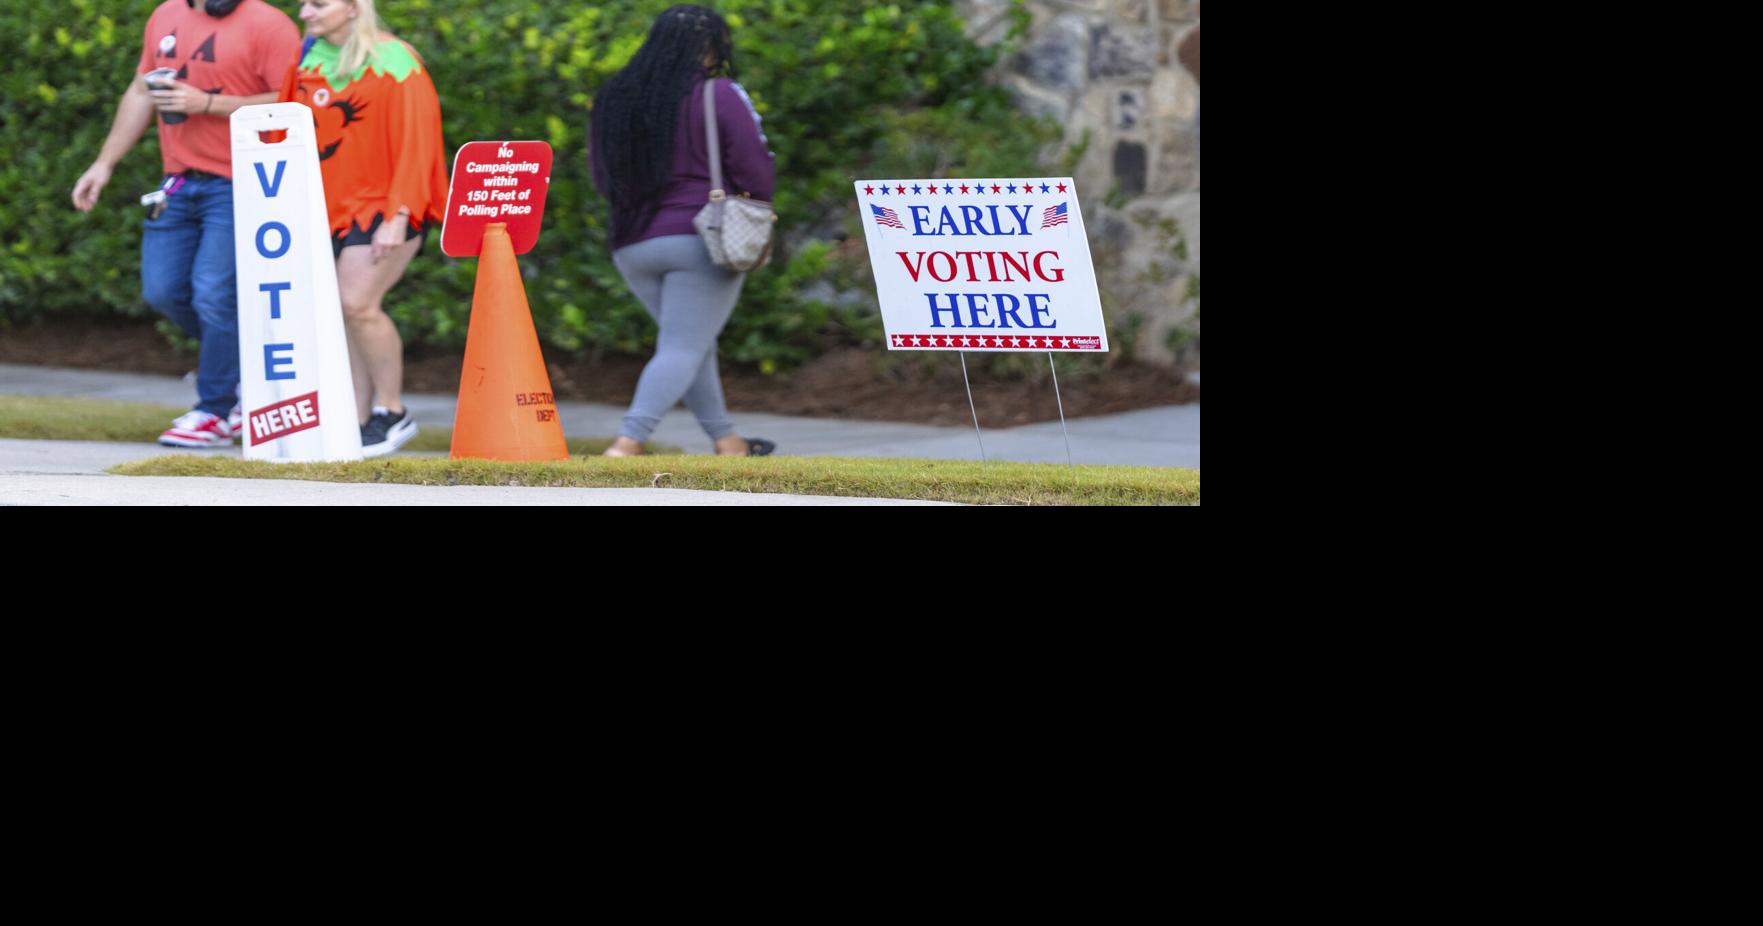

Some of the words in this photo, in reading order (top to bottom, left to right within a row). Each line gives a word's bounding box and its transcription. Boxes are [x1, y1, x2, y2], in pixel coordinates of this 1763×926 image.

[497, 147, 513, 158] No
[466, 161, 540, 175] Campaigning
[483, 176, 518, 187] within
[467, 191, 489, 202] 150
[490, 190, 516, 201] Feet
[518, 189, 531, 200] of
[458, 204, 498, 217] Polling
[500, 203, 532, 215] Place
[908, 204, 1034, 236] EARLY
[253, 160, 297, 381] VOTE
[896, 251, 1065, 283] VOTING
[924, 293, 1057, 329] HERE
[250, 399, 317, 438] HERE
